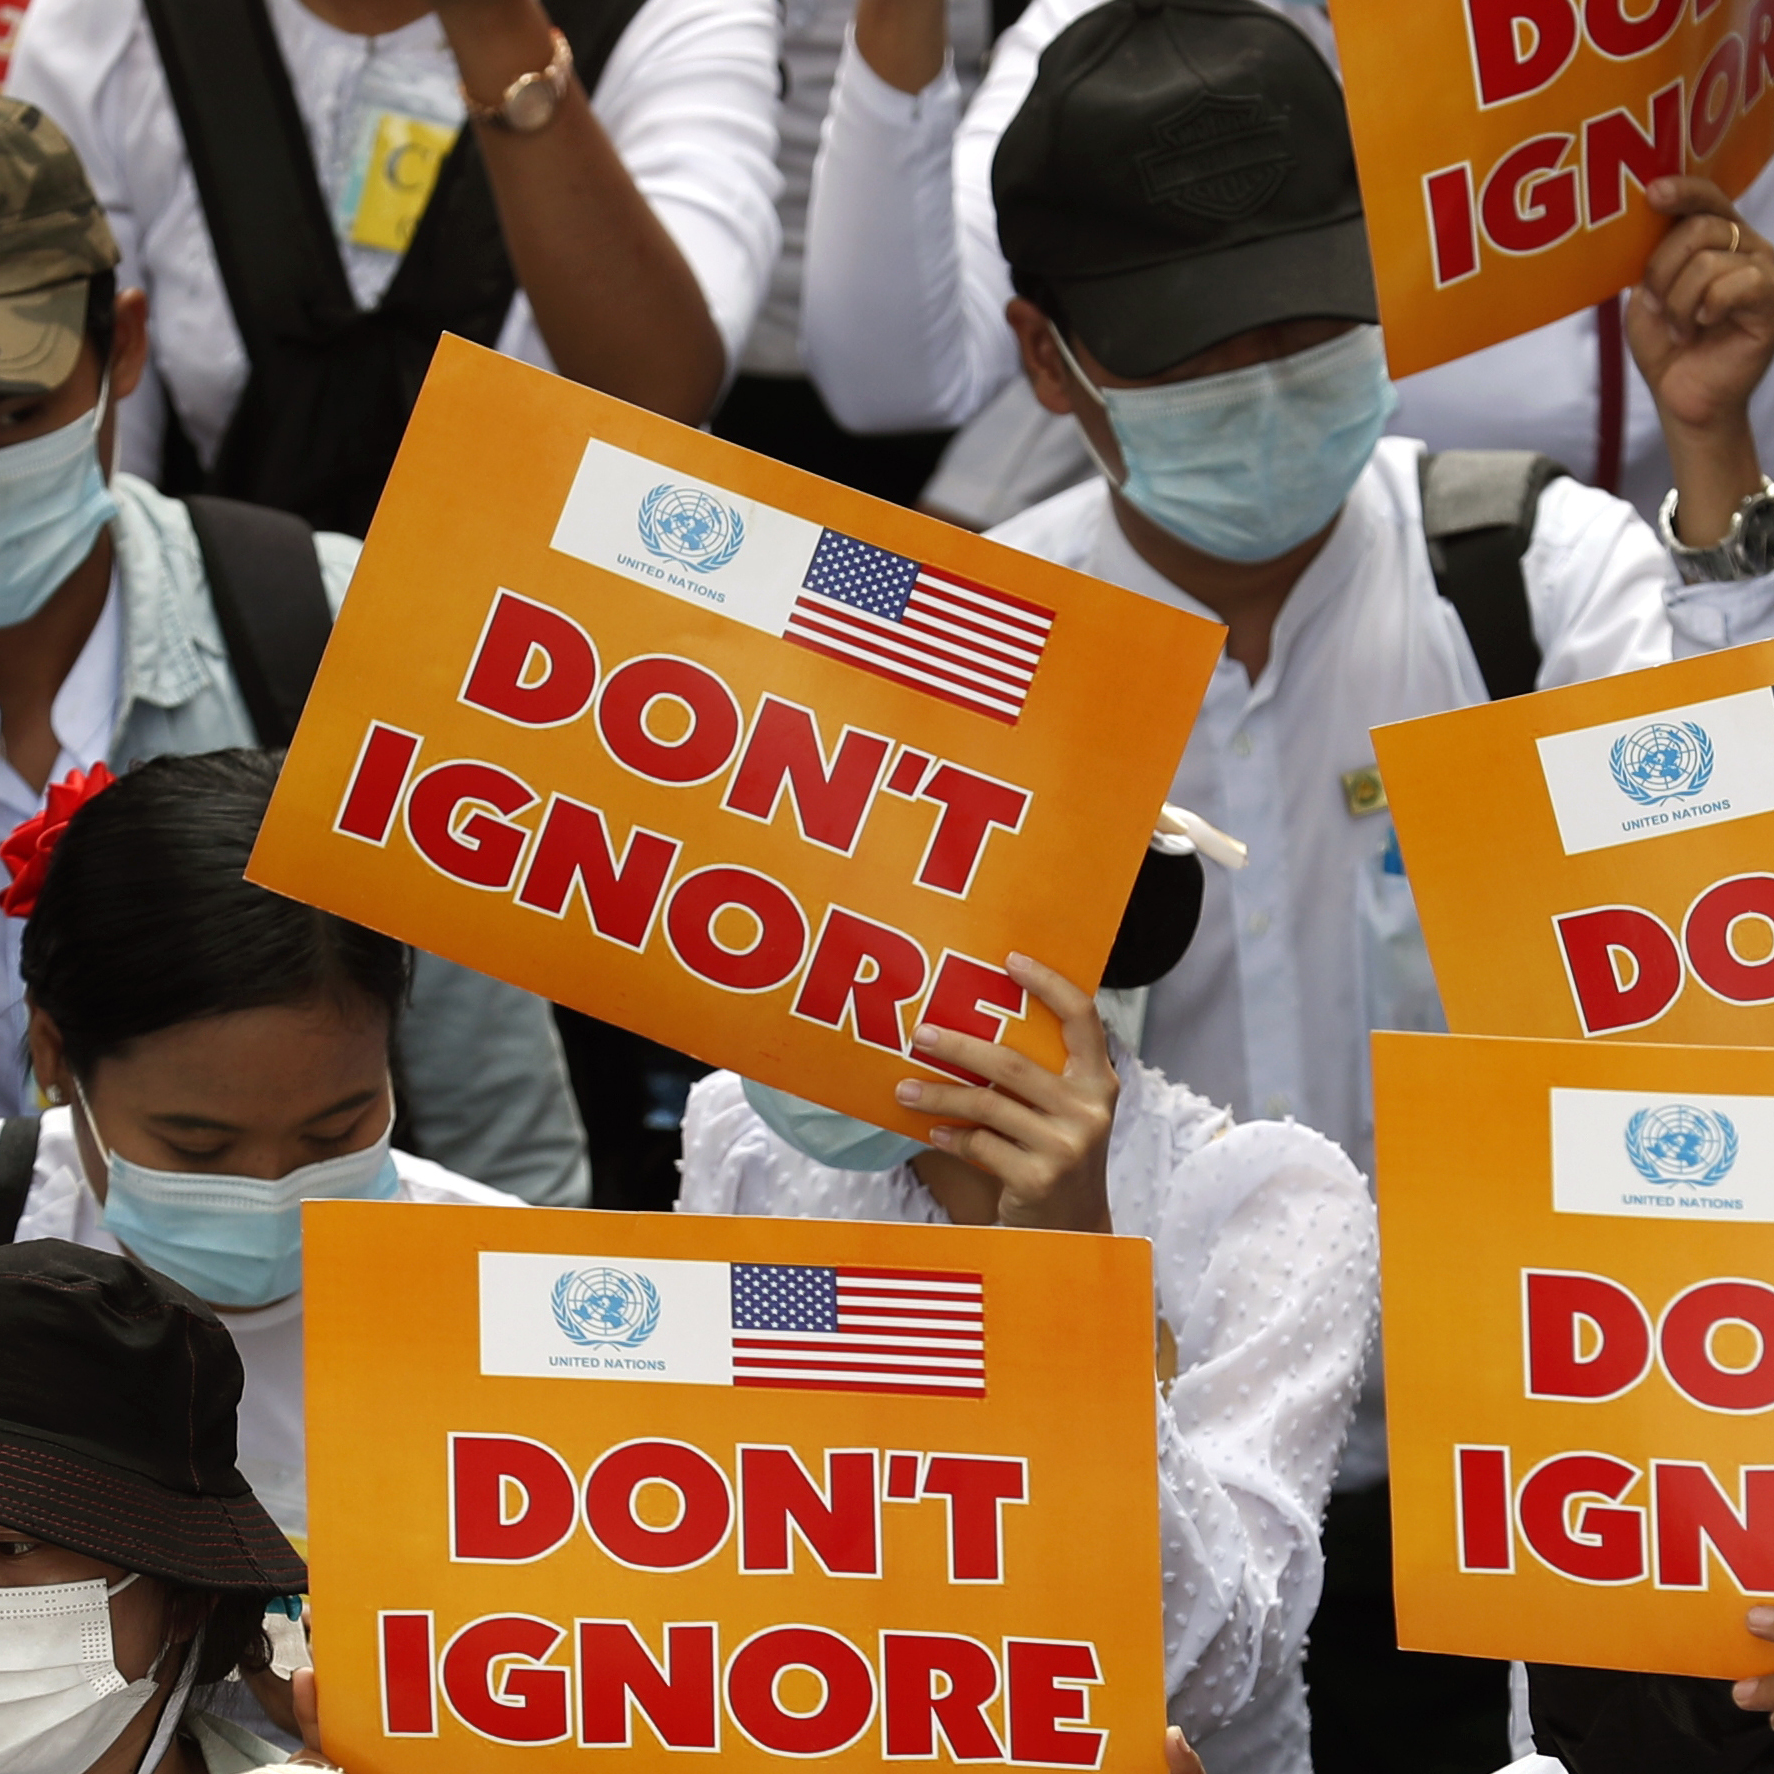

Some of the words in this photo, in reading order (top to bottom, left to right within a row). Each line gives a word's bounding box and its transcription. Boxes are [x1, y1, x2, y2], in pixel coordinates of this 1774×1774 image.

[616, 553, 663, 584] UNITED
[666, 571, 726, 604] NATIONS
[458, 587, 1033, 899] DON'T
[1621, 811, 1669, 834] UNITED
[1671, 798, 1731, 823] NATIONS
[333, 719, 1026, 1090] IGNORE
[1621, 1193, 1676, 1211] UNITED
[1678, 1195, 1744, 1211] NATIONS
[548, 1355, 601, 1371] UNITED
[603, 1356, 666, 1372] NATIONS
[448, 1431, 1029, 1585] DON'T
[378, 1610, 1110, 1770] IGNORE
